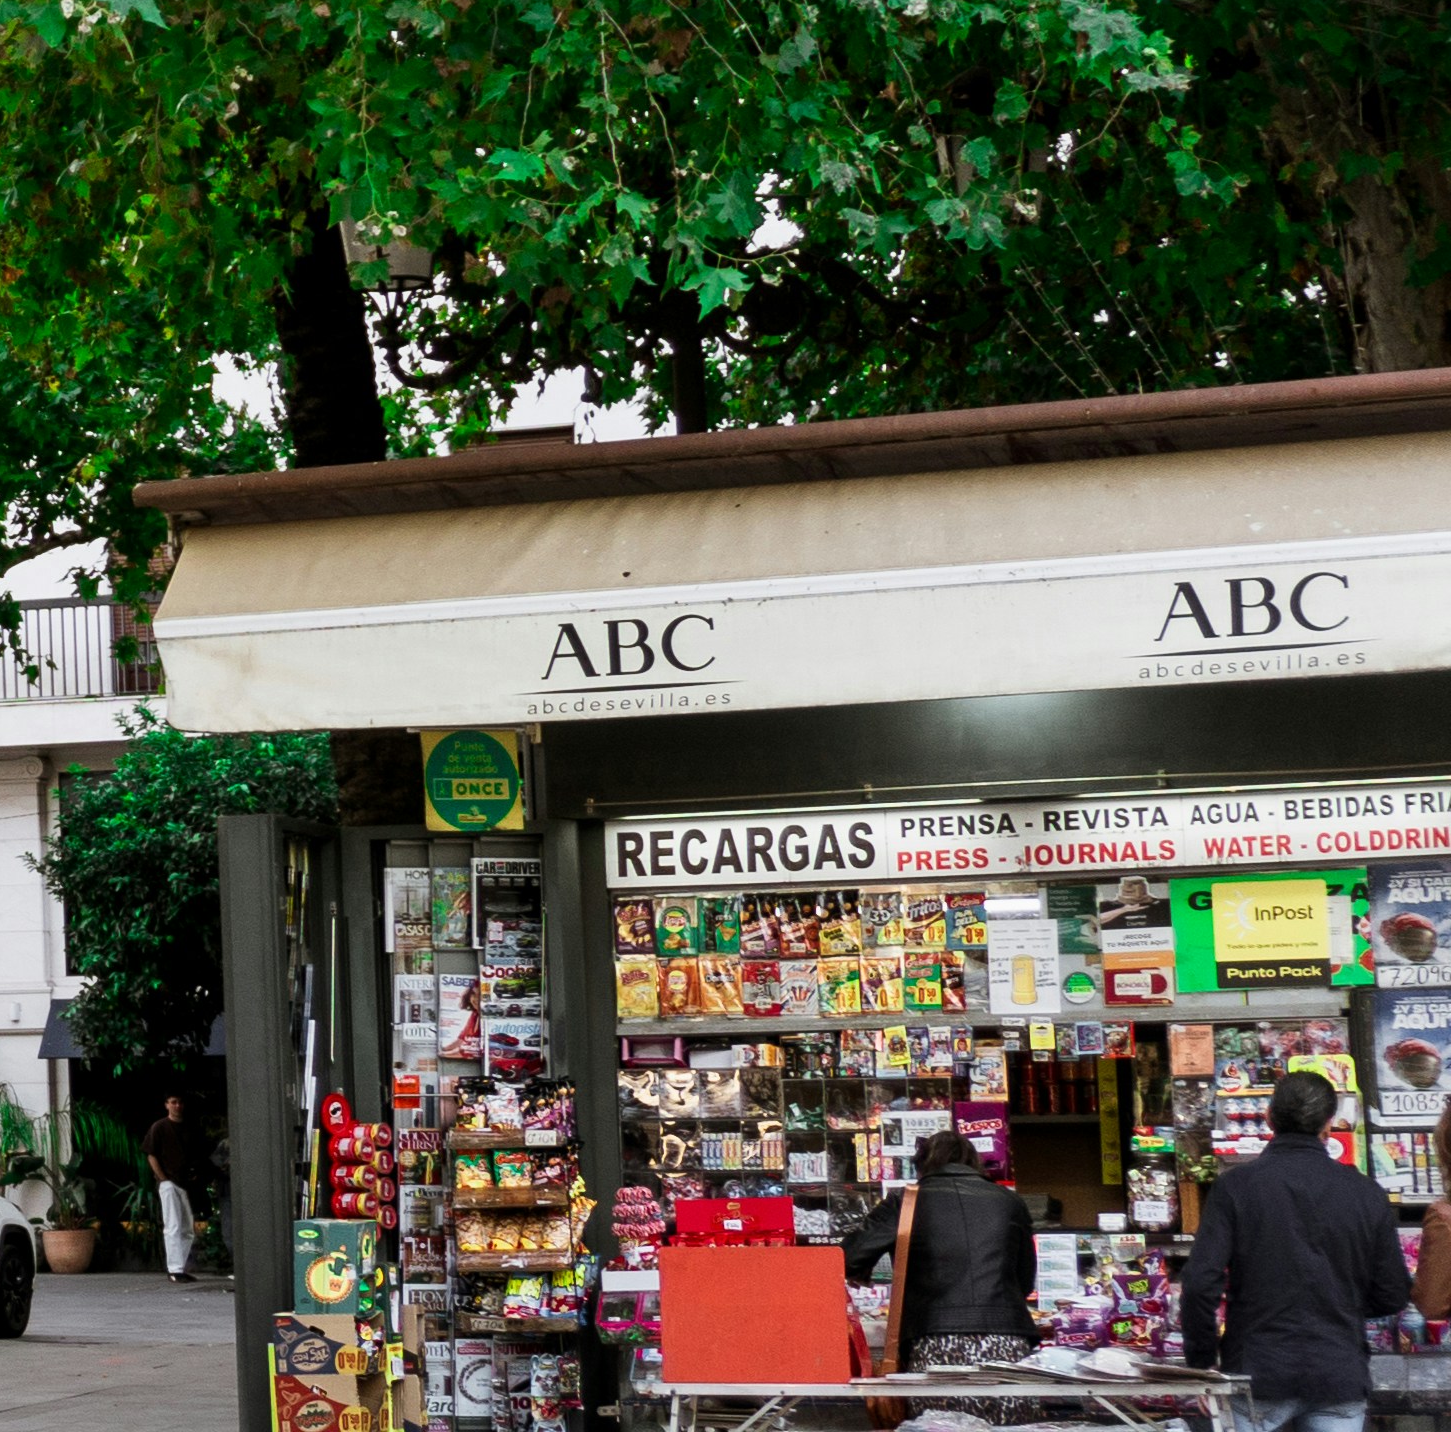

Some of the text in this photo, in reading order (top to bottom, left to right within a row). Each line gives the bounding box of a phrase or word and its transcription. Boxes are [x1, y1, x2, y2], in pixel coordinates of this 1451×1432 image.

[1154, 571, 1350, 642] ABC
[541, 614, 716, 680] ABC
[1138, 651, 1367, 679] abcdesevilla.es
[526, 690, 732, 716] abcdesevilla.es
[456, 782, 504, 796] ONCE
[900, 813, 1016, 838] PRENSA
[1042, 806, 1169, 833] REVISTA
[1190, 801, 1259, 826] AGUA
[1284, 795, 1394, 820] BEBIDAS
[616, 821, 876, 878] RECARGAS
[897, 848, 989, 872] PRESS
[1016, 839, 1176, 867] JOURNALS
[1203, 834, 1293, 859] WATER
[476, 862, 497, 875] CAR
[504, 861, 541, 875] DRIVER
[1255, 905, 1313, 921] InPost
[1226, 965, 1322, 979] Punto Pack
